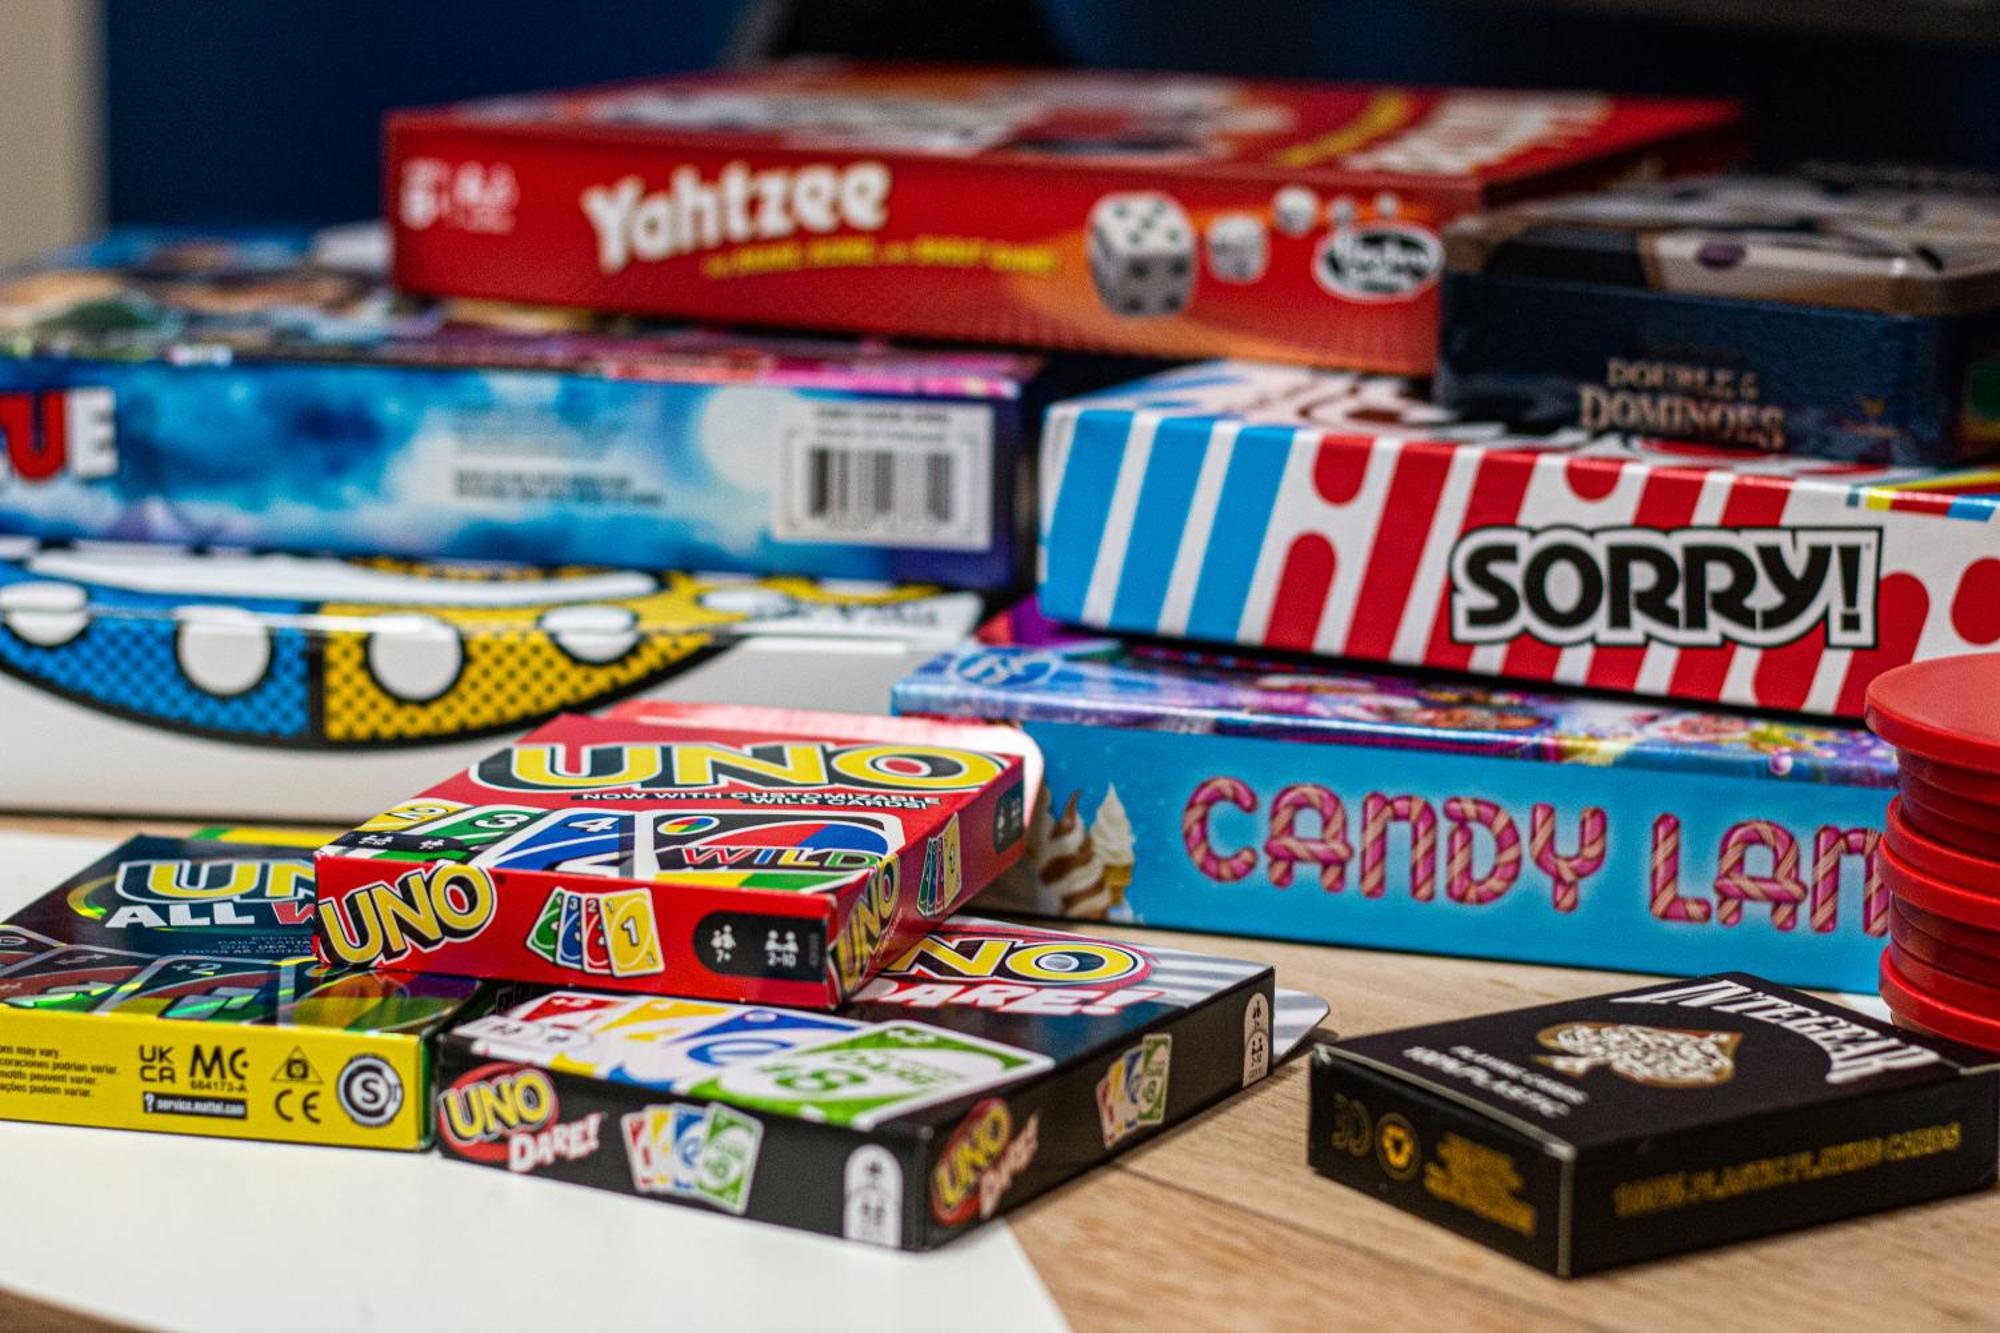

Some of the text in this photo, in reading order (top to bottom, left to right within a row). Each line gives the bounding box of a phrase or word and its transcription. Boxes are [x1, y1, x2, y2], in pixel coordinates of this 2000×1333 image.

[582, 161, 890, 273] Yahtzee
[1460, 537, 1867, 638] SORRY!
[482, 742, 1007, 790] UNO
[650, 792, 722, 800] WITH
[751, 797, 818, 805] WILD
[683, 846, 880, 869] WILD
[1181, 775, 1608, 913] CANDY
[104, 902, 255, 928] ALL
[316, 862, 498, 965] UNO
[835, 854, 899, 996] UNO
[16, 1047, 36, 1056] may
[140, 1046, 174, 1065] UK
[275, 1089, 321, 1124] CE
[438, 1068, 551, 1144] UNO
[508, 1112, 602, 1172] DARE!
[935, 1103, 1012, 1208] UNO
